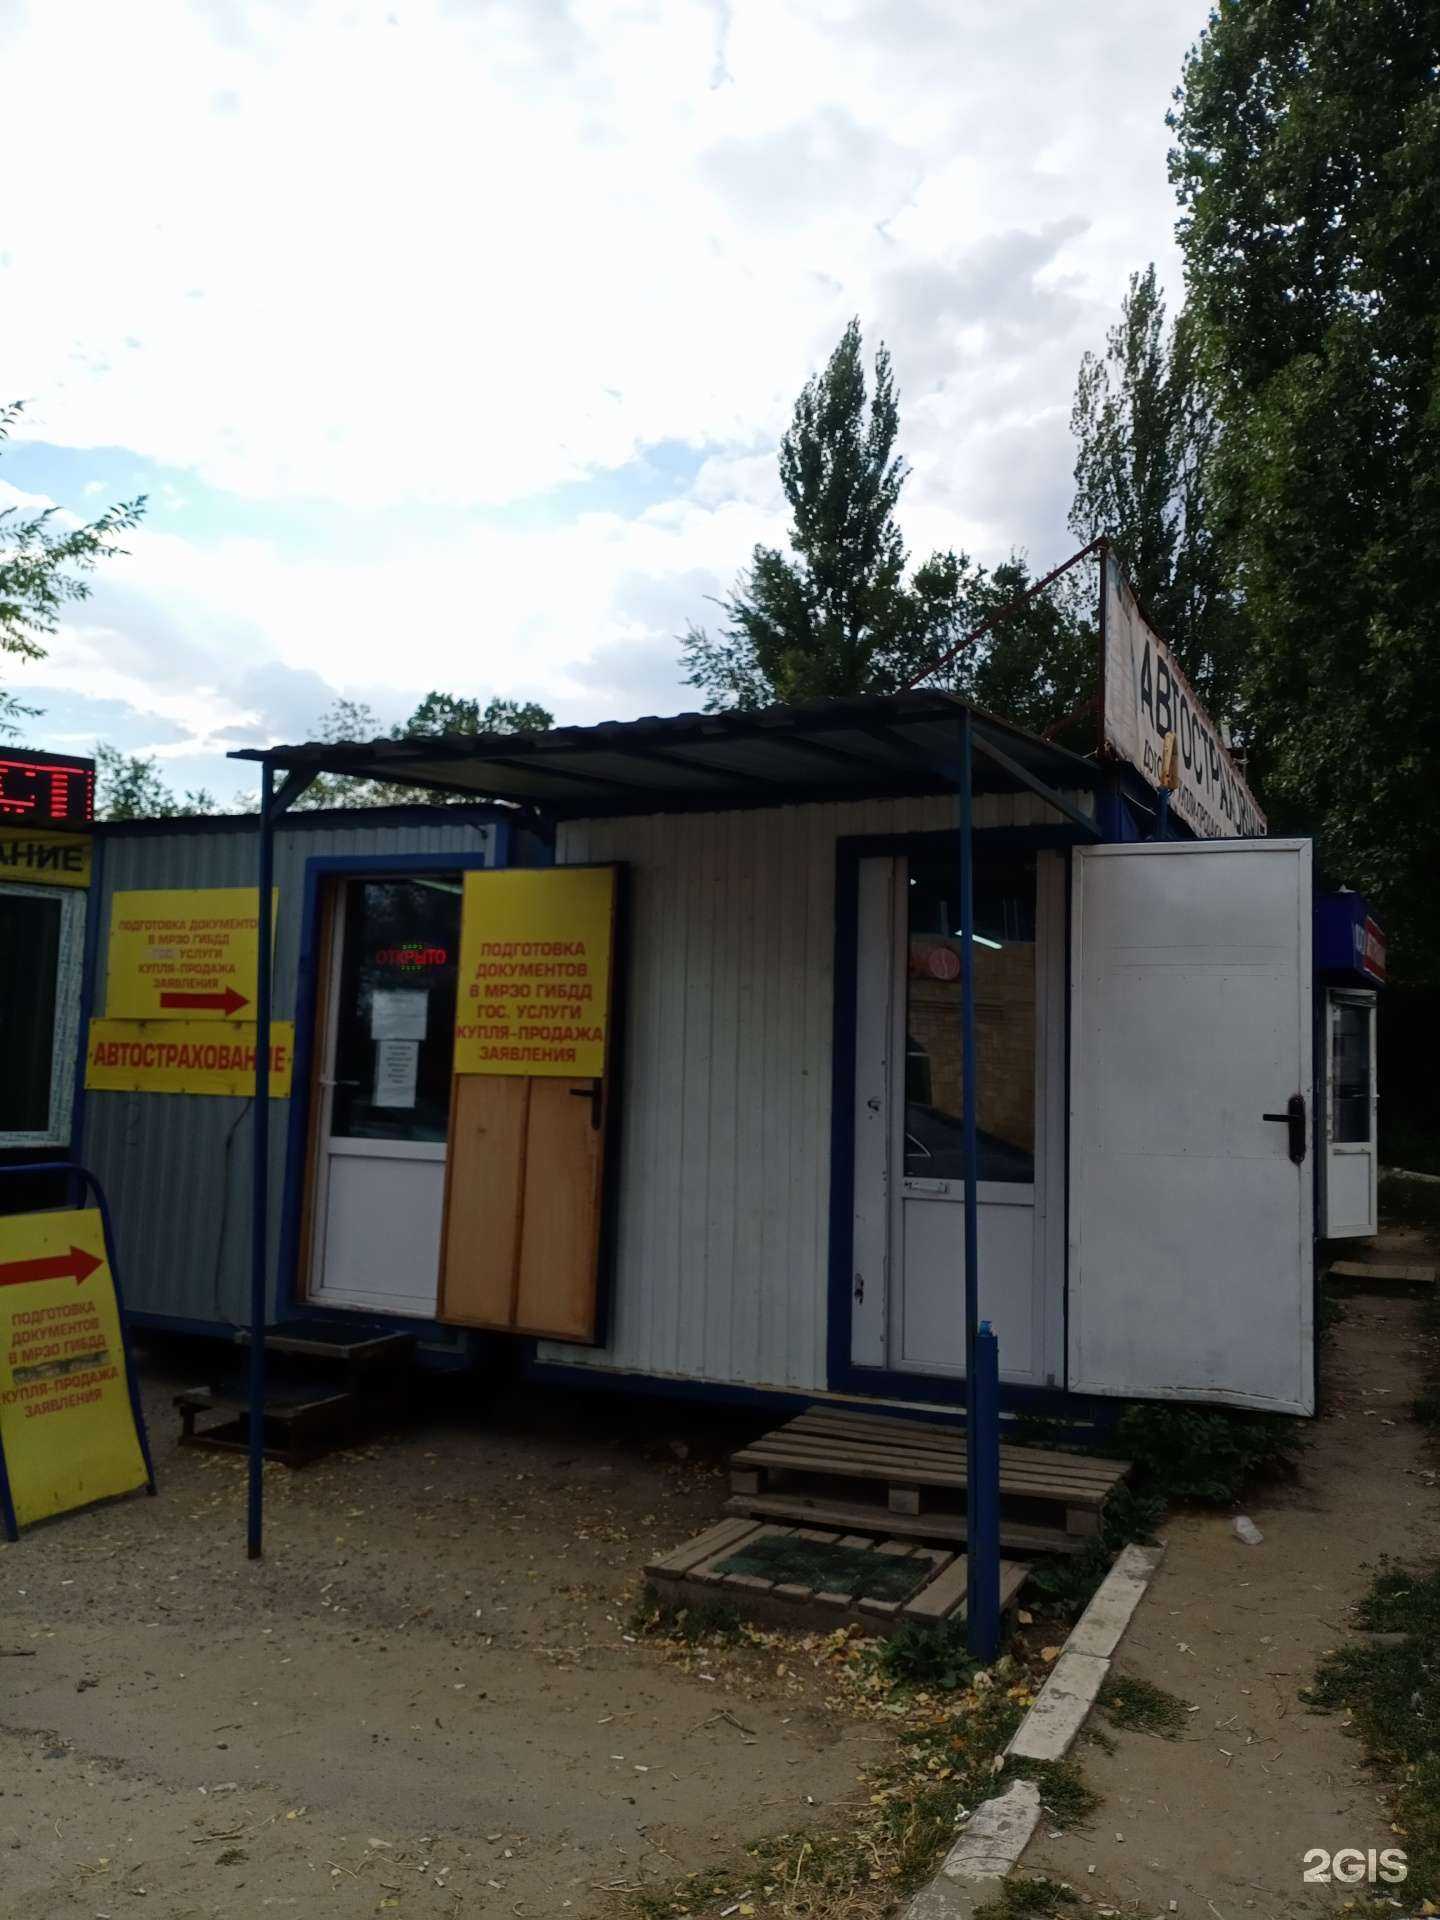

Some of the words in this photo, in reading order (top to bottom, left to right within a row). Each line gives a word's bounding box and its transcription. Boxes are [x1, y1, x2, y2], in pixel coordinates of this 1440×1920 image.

[119, 920, 186, 932] ПОДГОТОВКА
[189, 919, 258, 932] ДОКУМЕНТО
[179, 948, 223, 960] УСЛУГИ
[480, 942, 586, 958] ПОДГОТОВКА
[476, 963, 588, 980] ДОКУМЕНТОВ
[469, 984, 479, 998] В
[536, 984, 593, 1002] ГИБДД
[477, 1005, 510, 1020] ГОС.
[516, 1004, 582, 1020] УСЛУГИ
[456, 1026, 603, 1043] КУПЛЯ-ПРОДАЖА
[94, 1042, 286, 1073] АВТОСТРАХОВАНЕ
[479, 1048, 576, 1062] ЗАЯВЛЕНИЯ
[11, 1301, 96, 1327] ПОДГОТОВКА
[11, 1317, 99, 1347] ДОКУМЕНТОВ
[24, 1388, 103, 1418] ЗАЯВЛЕНИЯ
